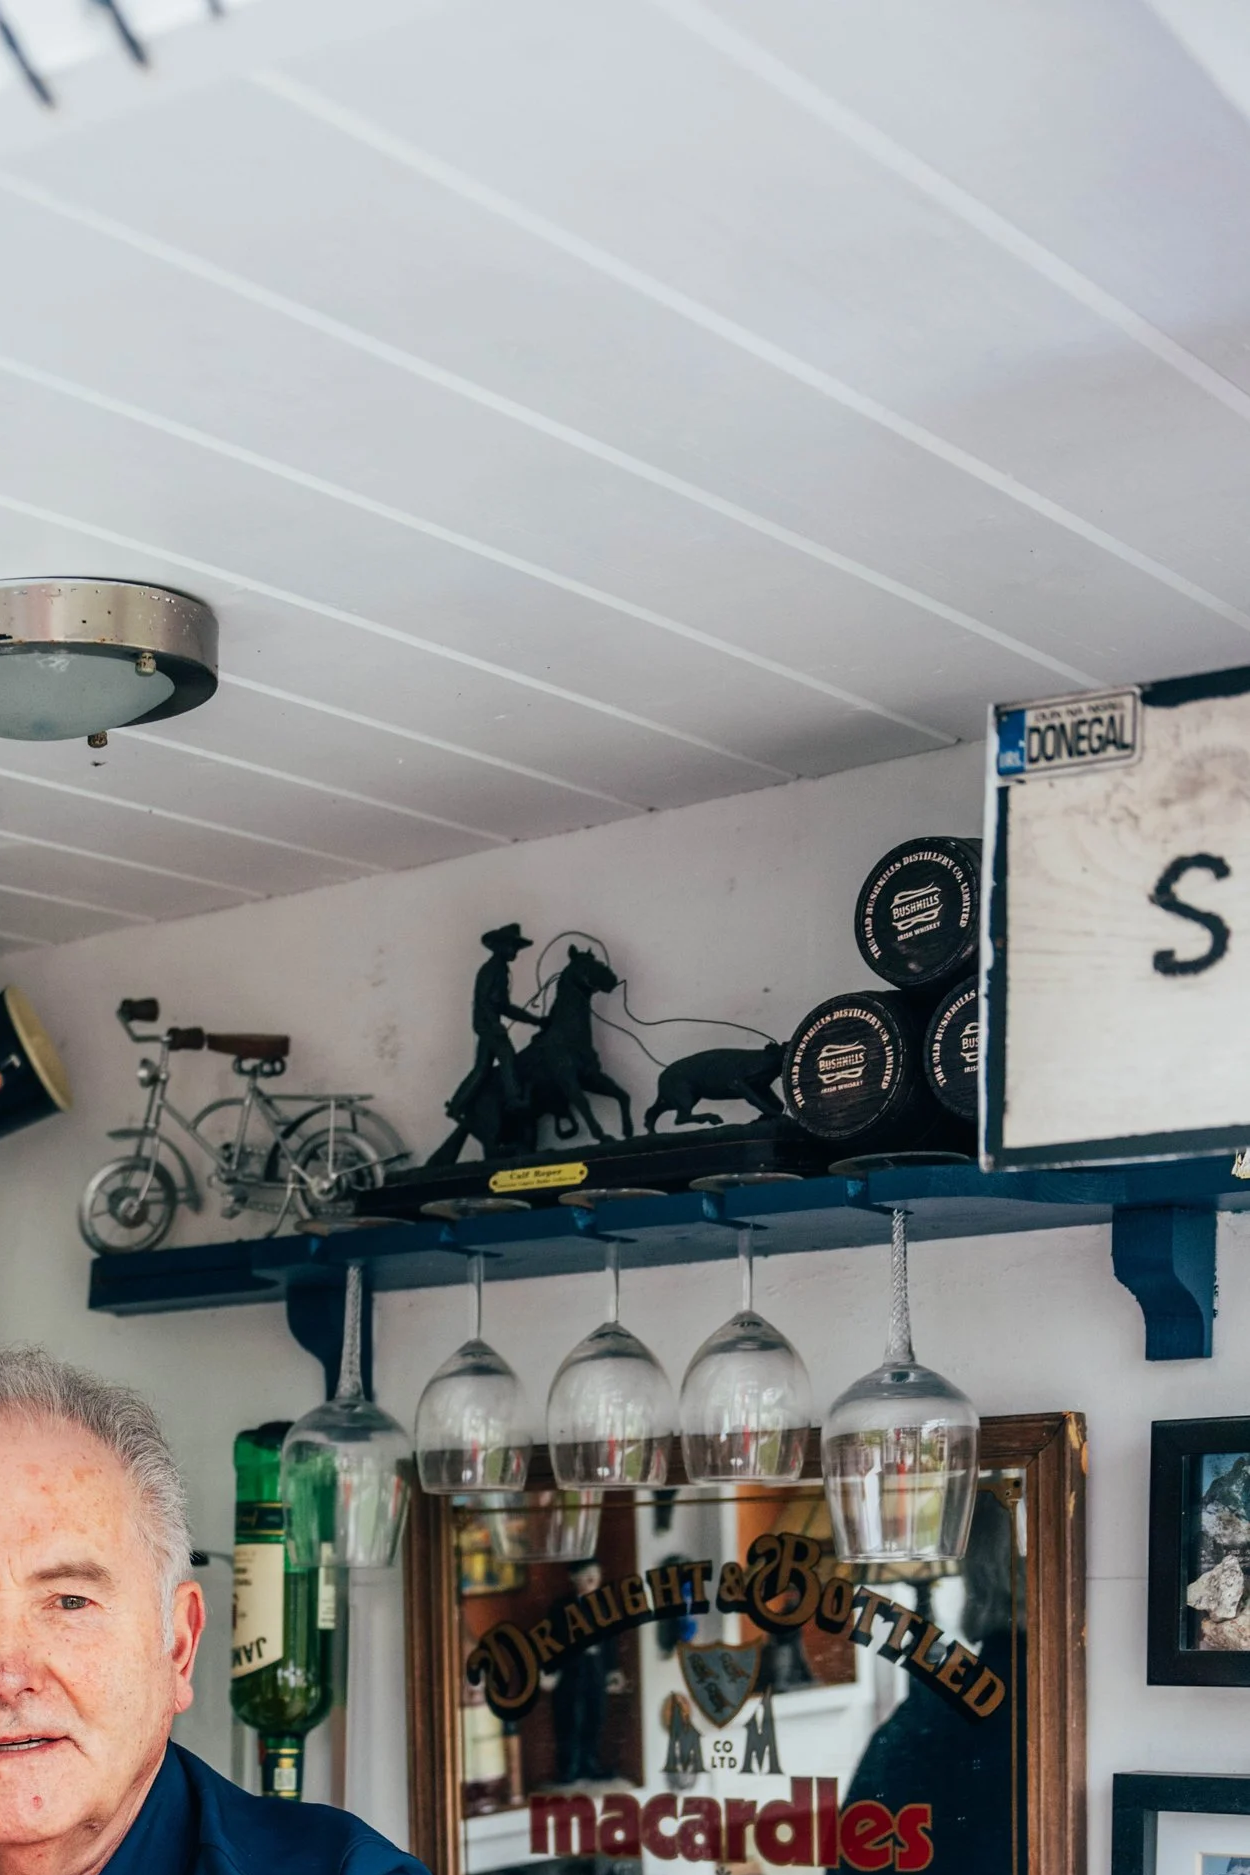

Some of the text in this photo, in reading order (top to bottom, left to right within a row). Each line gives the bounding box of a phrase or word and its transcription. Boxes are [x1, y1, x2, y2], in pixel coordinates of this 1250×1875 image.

[1027, 713, 1134, 764] DONEGAL
[892, 893, 940, 920] BUSHMILLS
[959, 882, 971, 928] LIMITED
[897, 921, 942, 942] IRISH WHISKEY
[934, 989, 977, 1041] BUSHMILLS
[818, 1051, 865, 1072] BUSHMILLS
[881, 1045, 894, 1090] LIMITED
[467, 1532, 1006, 1720] DRAUGHT & BOTTLED
[710, 1756, 738, 1770] LTD
[712, 1739, 734, 1753] CO
[529, 1776, 934, 1872] macardles
